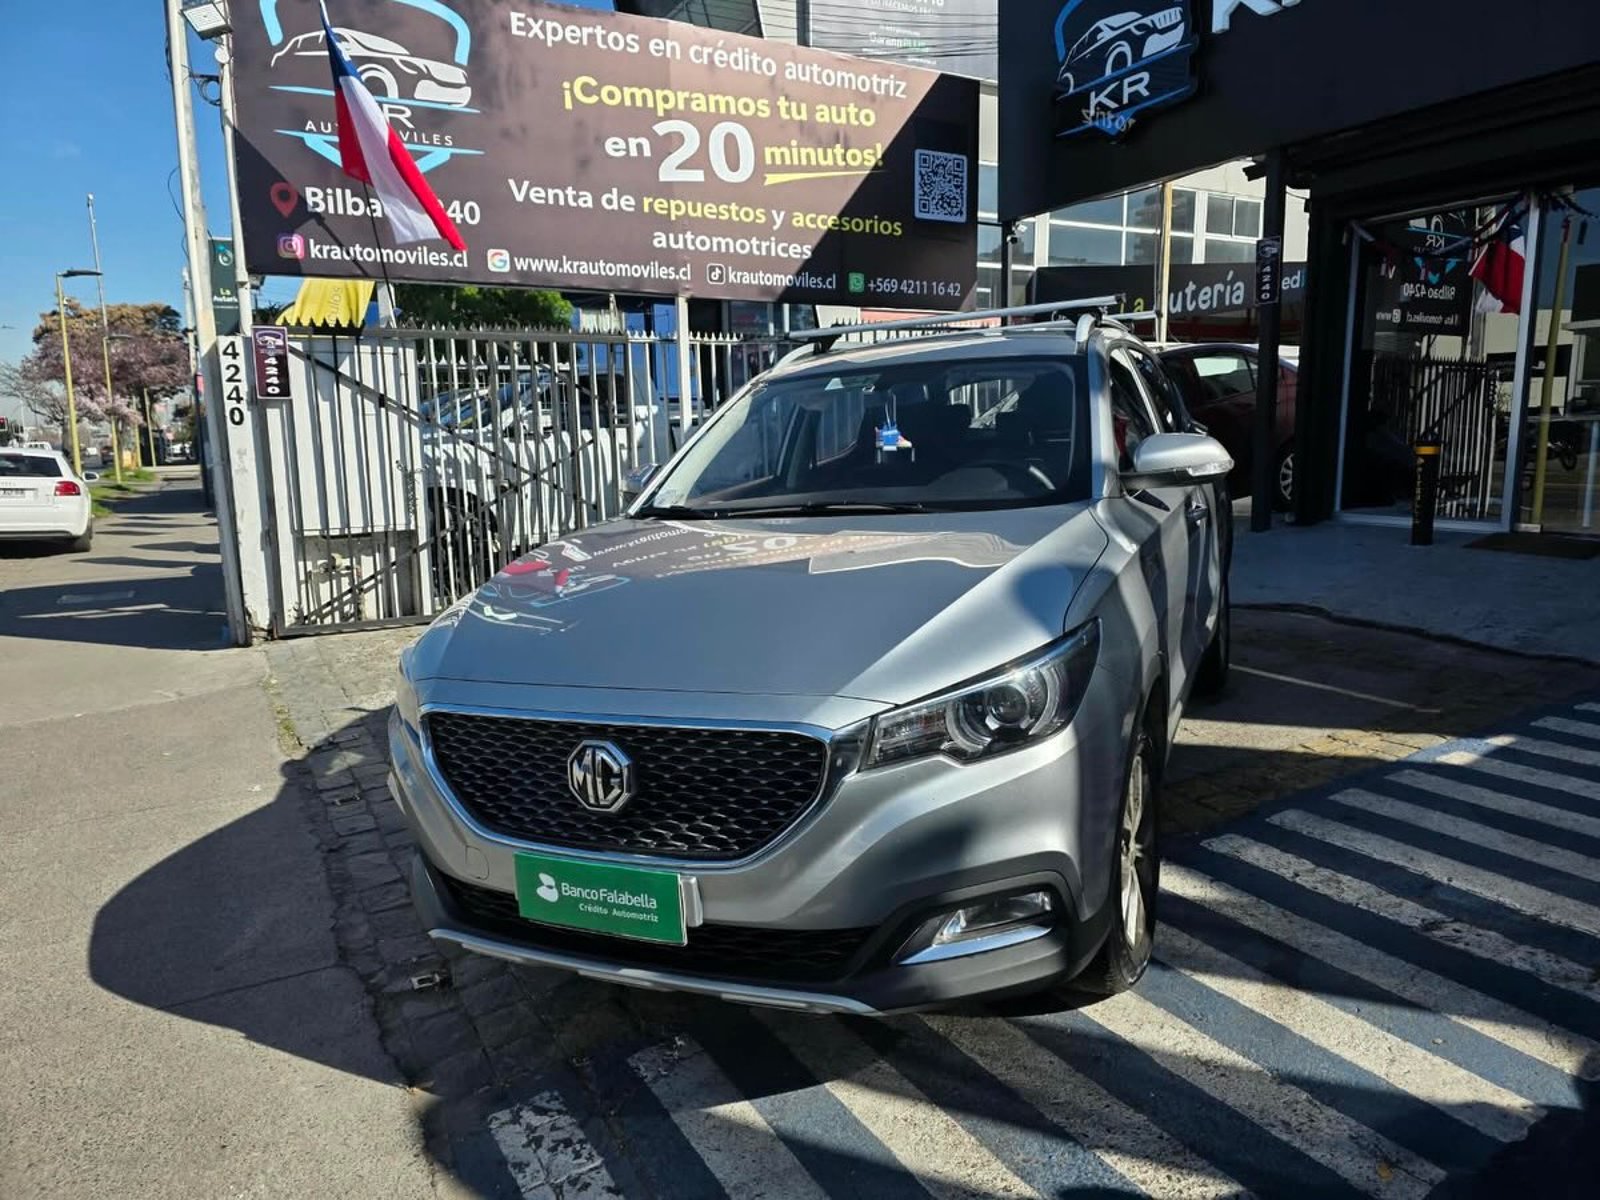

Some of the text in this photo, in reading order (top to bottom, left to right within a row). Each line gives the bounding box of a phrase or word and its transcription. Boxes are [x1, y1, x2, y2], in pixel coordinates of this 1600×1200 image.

[510, 11, 908, 98] Expertos en crédito automotriz
[562, 76, 877, 128] ¡Compramos tu auto
[1089, 71, 1151, 117] KR
[383, 104, 415, 129] R
[604, 119, 884, 184] en 20 minutos!
[304, 187, 481, 225] Bilba 40
[508, 179, 903, 237] Venta de repuestos y accesorios
[309, 239, 469, 268] krautomoviles.cl
[652, 229, 813, 260] automotrices
[514, 254, 692, 281] www.krautomoviles.cl
[728, 259, 837, 290] krautomoviles.cl
[1261, 266, 1271, 300] 4240
[867, 279, 961, 296] +569 4211 16 42
[1162, 270, 1245, 314] utería
[222, 341, 245, 426] 4240
[264, 356, 281, 394] 4240
[572, 748, 622, 806] MG
[579, 903, 659, 923] Crédito Automotriz
